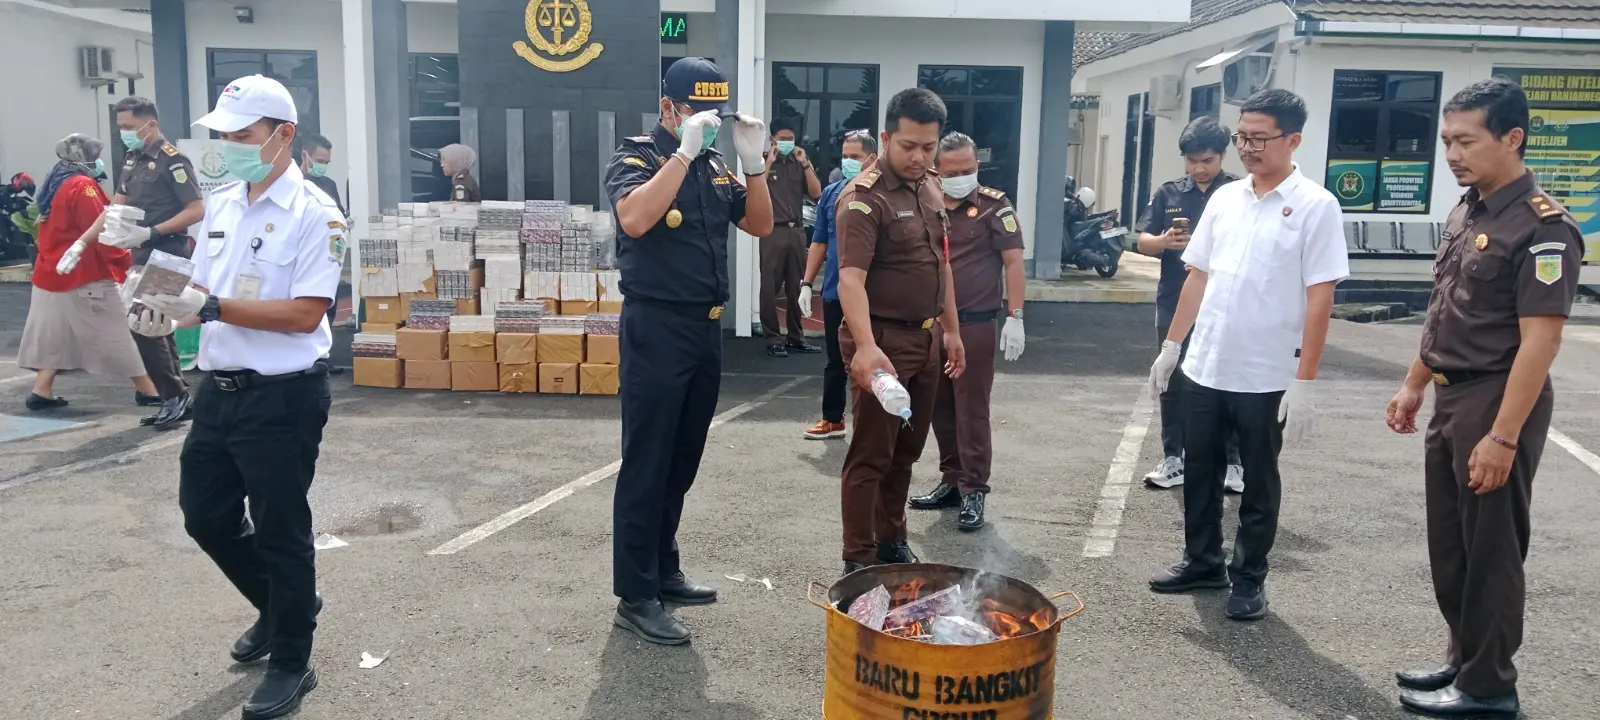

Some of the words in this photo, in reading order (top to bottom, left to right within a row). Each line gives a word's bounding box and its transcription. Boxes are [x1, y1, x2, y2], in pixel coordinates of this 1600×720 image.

[1521, 75, 1565, 88] BIDANG
[1526, 90, 1550, 101] EJARI
[855, 653, 920, 700] BARU
[935, 661, 1042, 705] BANGKIT
